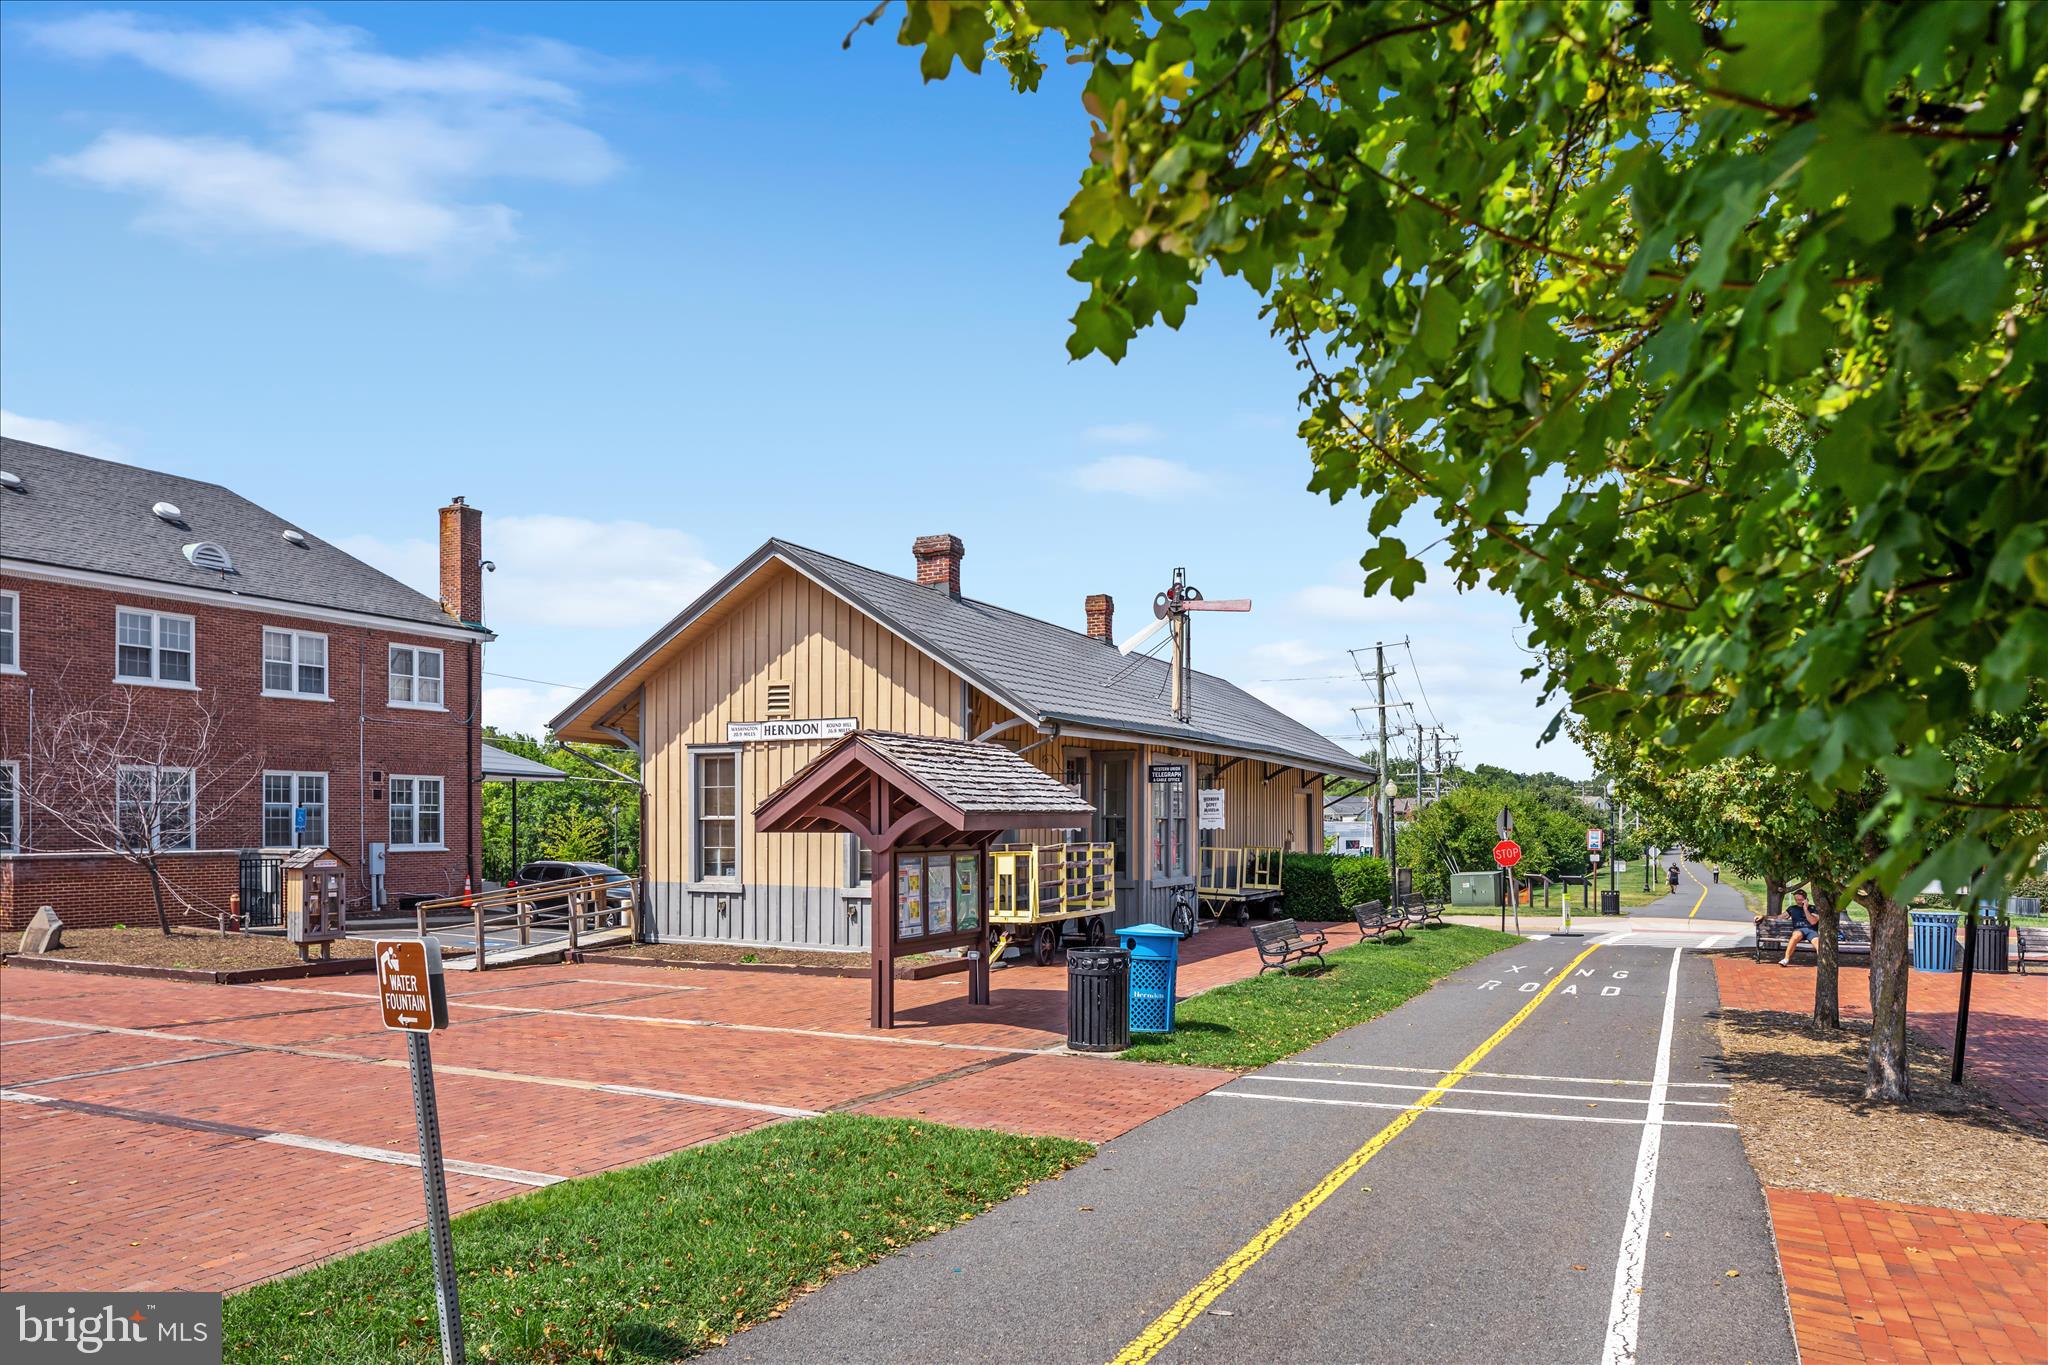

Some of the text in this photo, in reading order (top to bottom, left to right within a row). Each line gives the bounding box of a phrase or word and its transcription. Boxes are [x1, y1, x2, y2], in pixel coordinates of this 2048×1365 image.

[764, 723, 819, 736] HERNDON
[1495, 847, 1519, 860] STOP
[1504, 965, 1630, 979] XING
[389, 974, 418, 992] WATER
[1477, 980, 1622, 996] ROAD
[385, 993, 427, 1012] FOUNTAIN
